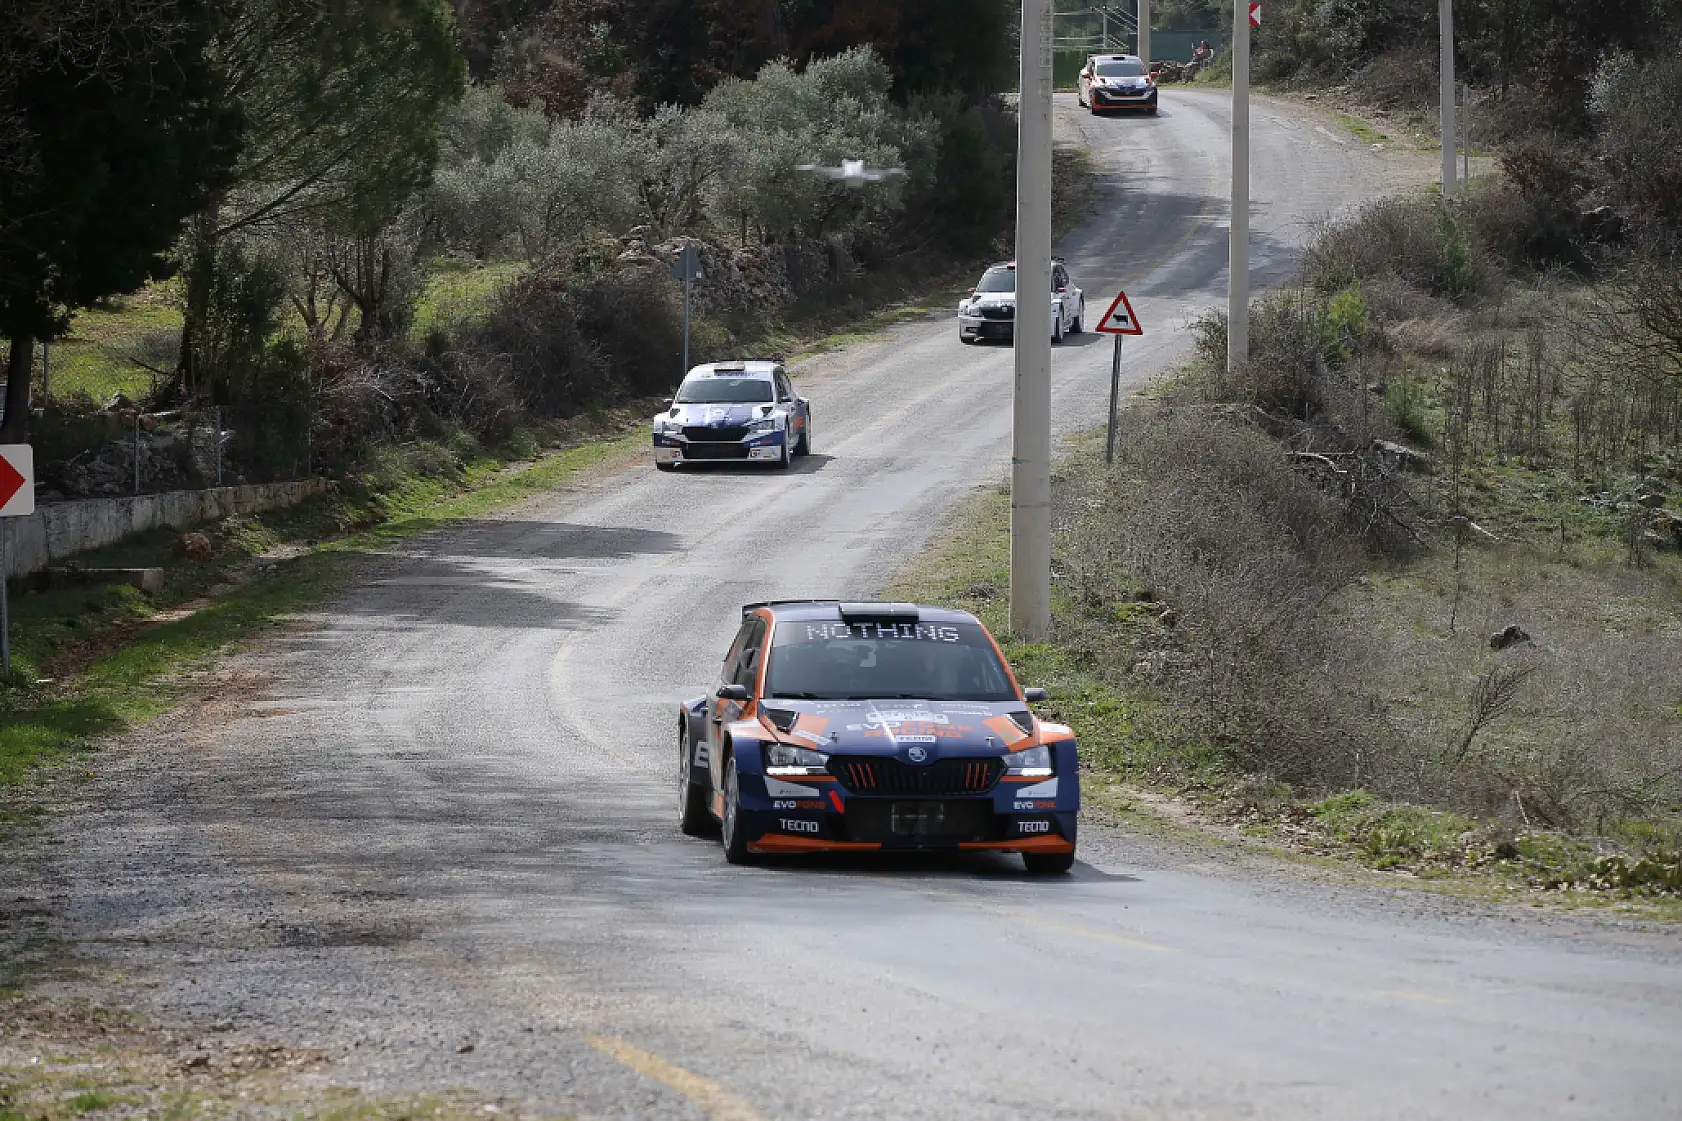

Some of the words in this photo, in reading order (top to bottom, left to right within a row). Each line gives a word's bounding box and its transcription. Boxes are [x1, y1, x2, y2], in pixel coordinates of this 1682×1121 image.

[806, 622, 959, 643] NOTHING
[779, 818, 819, 832] TECNO
[1017, 821, 1049, 832] TECNO
